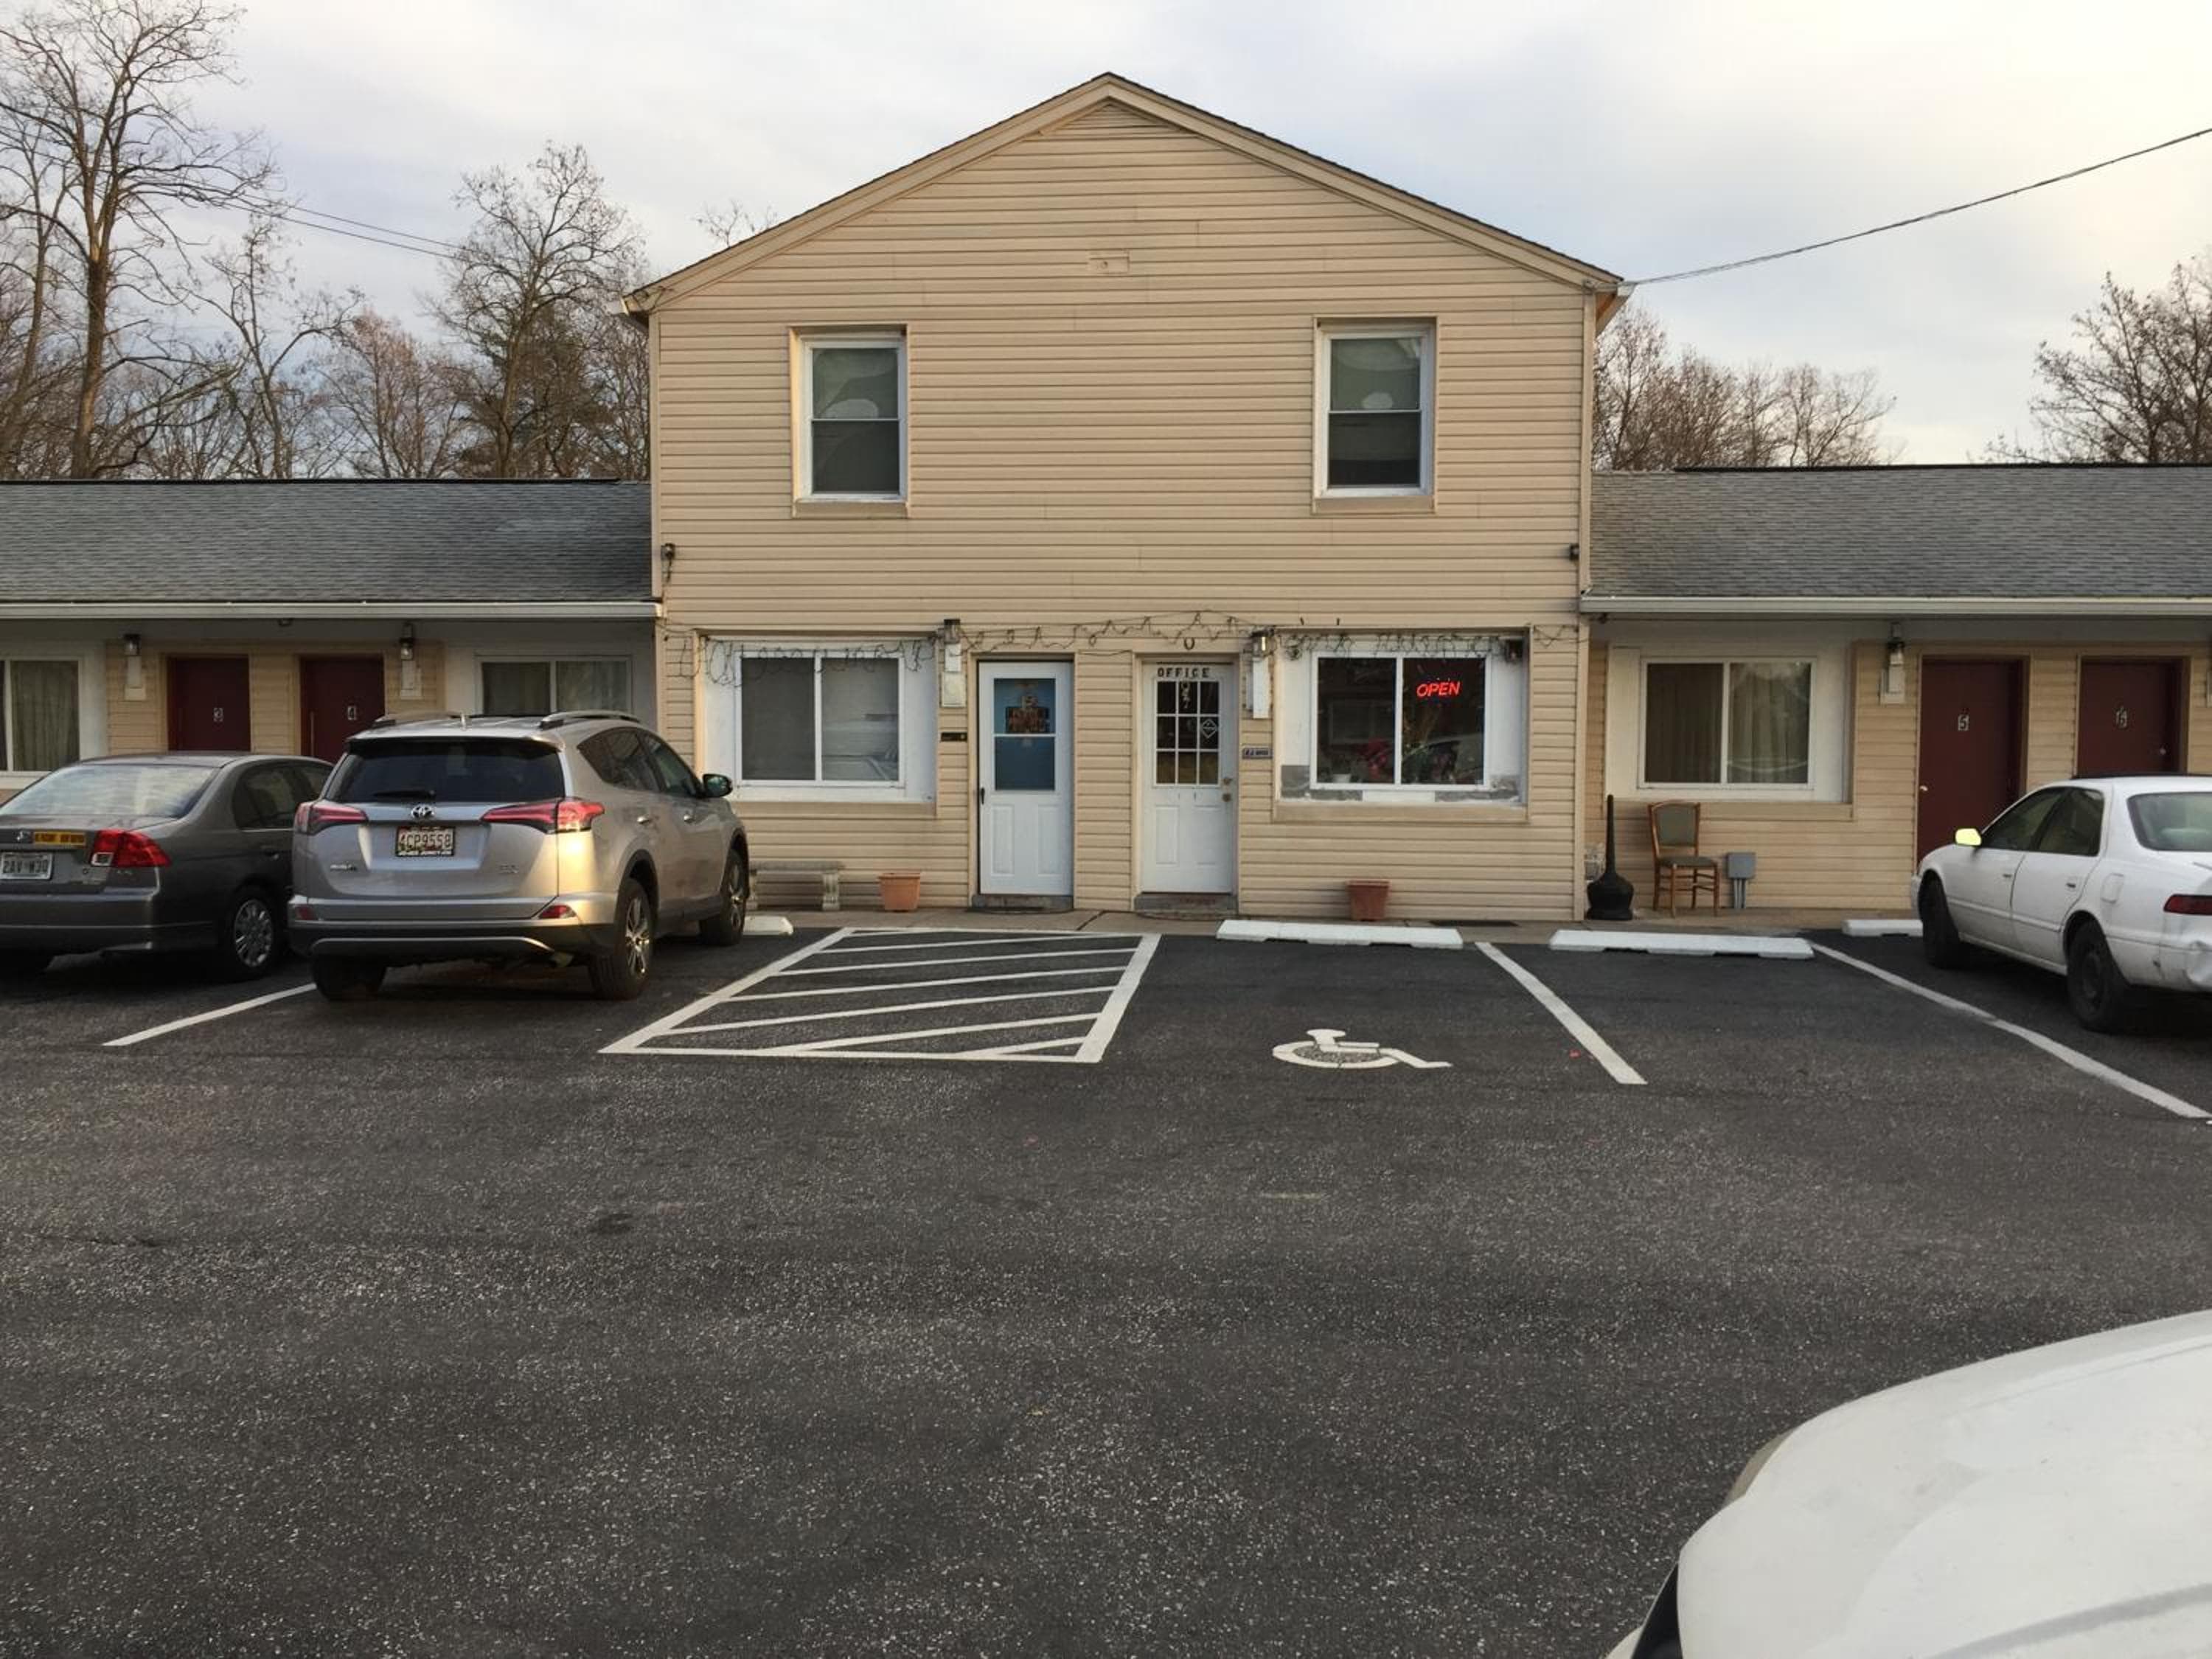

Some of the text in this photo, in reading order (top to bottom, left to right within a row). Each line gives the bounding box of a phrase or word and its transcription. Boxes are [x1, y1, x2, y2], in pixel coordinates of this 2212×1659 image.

[1157, 667, 1209, 678] OFFICE
[1416, 681, 1461, 697] OPEN
[1958, 714, 1969, 731] 5
